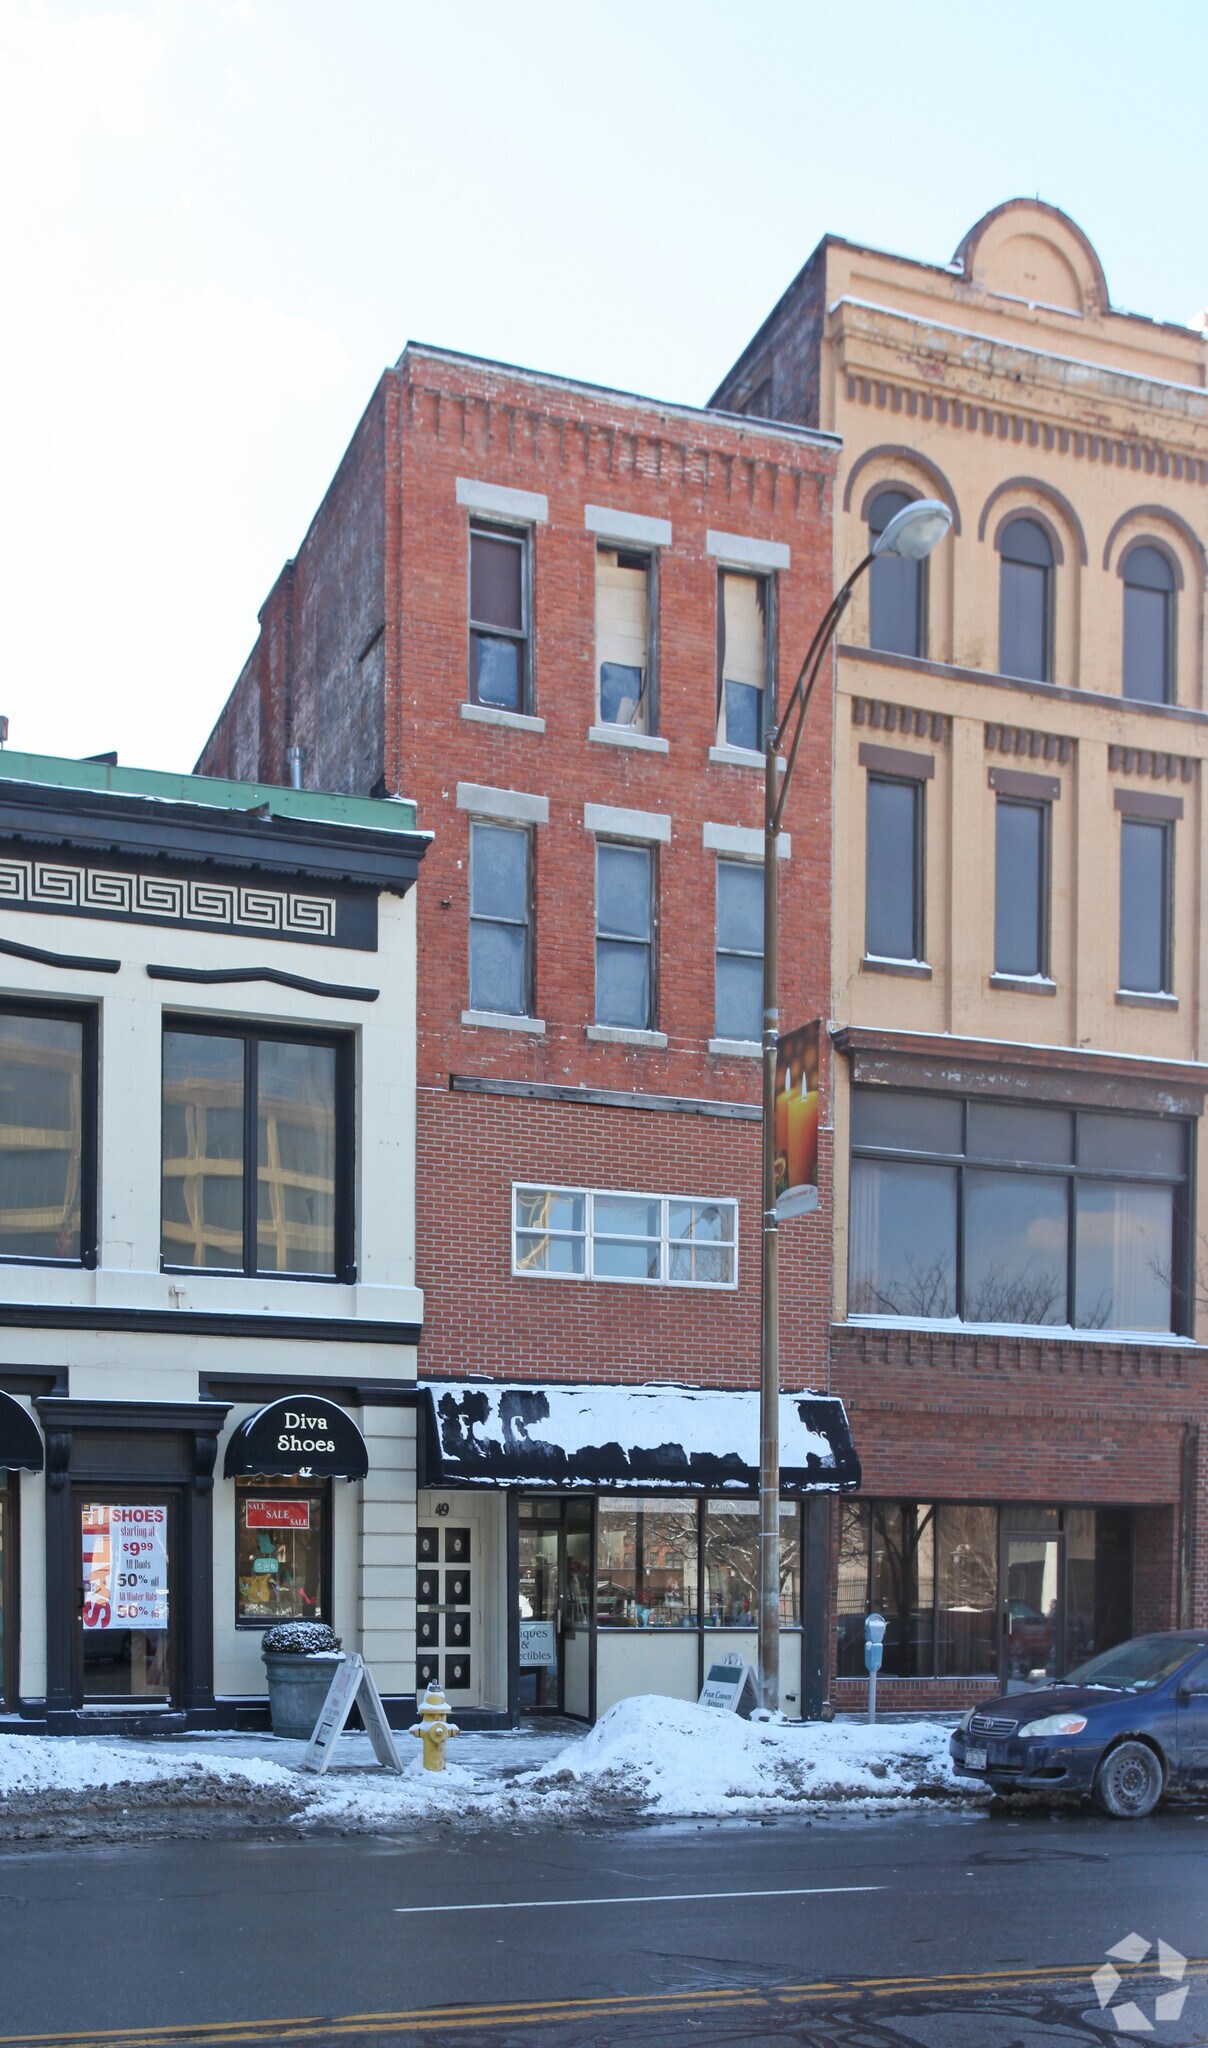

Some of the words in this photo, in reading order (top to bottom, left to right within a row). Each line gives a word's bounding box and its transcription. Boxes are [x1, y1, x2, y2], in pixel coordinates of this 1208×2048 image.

[285, 1412, 328, 1430] Diva
[277, 1434, 336, 1452] Shoes
[299, 1466, 313, 1476] 47
[111, 1509, 164, 1523] SHOES
[266, 1510, 290, 1519] SALE
[435, 1502, 450, 1517] 49
[289, 1518, 308, 1526] SALE
[120, 1525, 147, 1539] starting
[148, 1525, 156, 1537] at
[82, 1507, 111, 1629] SALE
[134, 1559, 151, 1569] Boots
[116, 1573, 148, 1587] 50%
[116, 1605, 148, 1619] 50%
[521, 1641, 529, 1649] &
